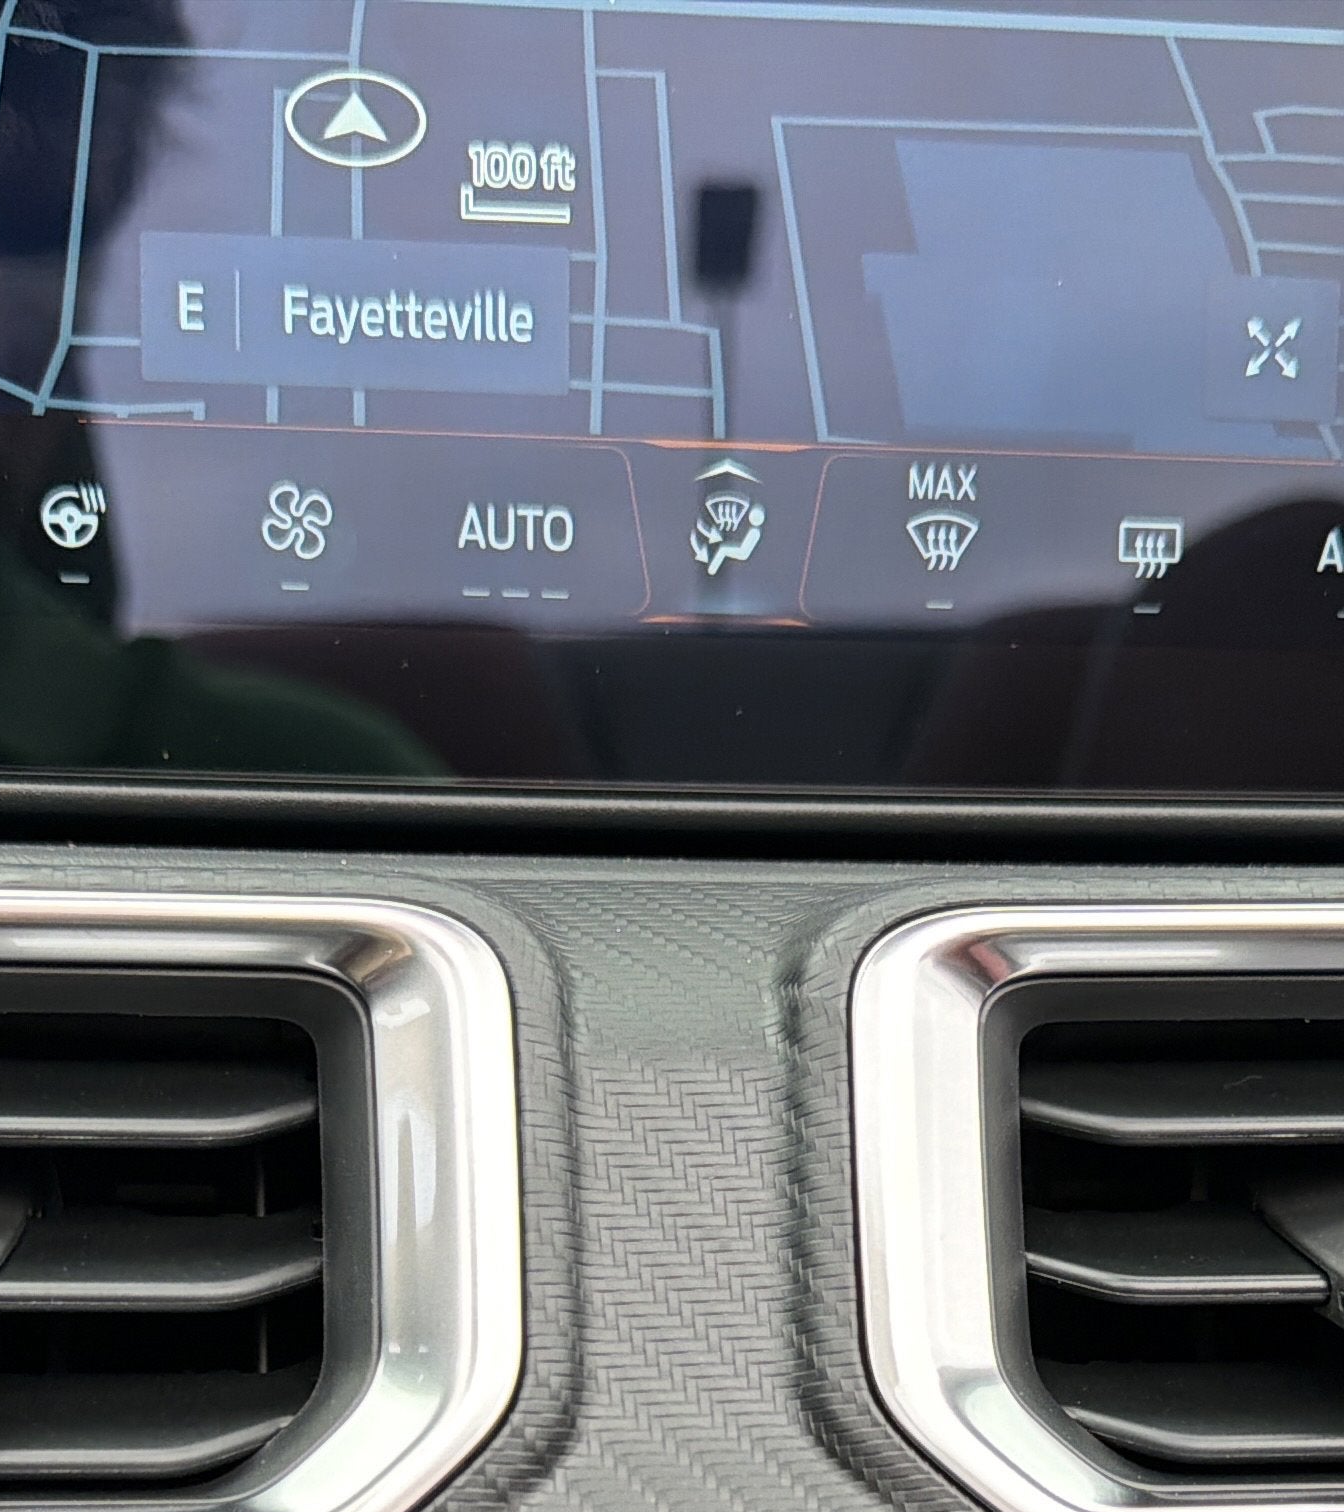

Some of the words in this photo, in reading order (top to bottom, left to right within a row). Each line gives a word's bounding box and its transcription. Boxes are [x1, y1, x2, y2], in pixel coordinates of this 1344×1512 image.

[468, 140, 537, 189] 100
[540, 142, 576, 192] ft
[178, 281, 206, 332] E
[283, 284, 535, 345] Fayetteville
[908, 463, 978, 502] MAX
[458, 505, 575, 552] AUTO
